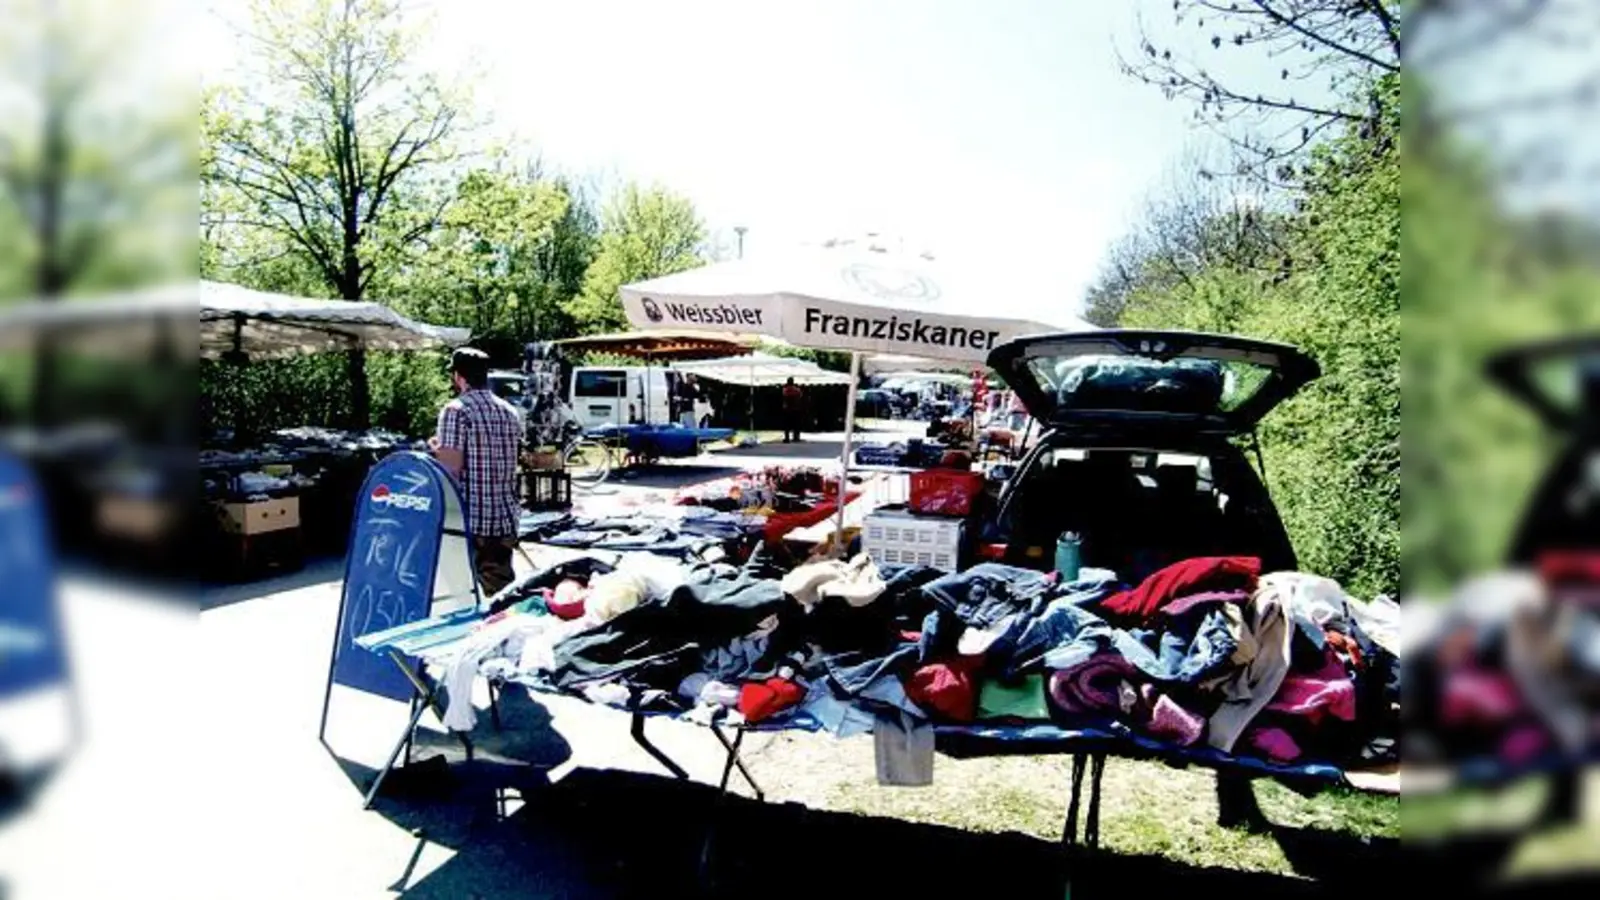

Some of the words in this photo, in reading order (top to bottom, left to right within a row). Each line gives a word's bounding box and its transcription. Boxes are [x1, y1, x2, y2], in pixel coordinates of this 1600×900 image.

[664, 300, 764, 327] Weissbier
[804, 307, 1001, 351] Franziskaner
[386, 492, 432, 512] PEPSI
